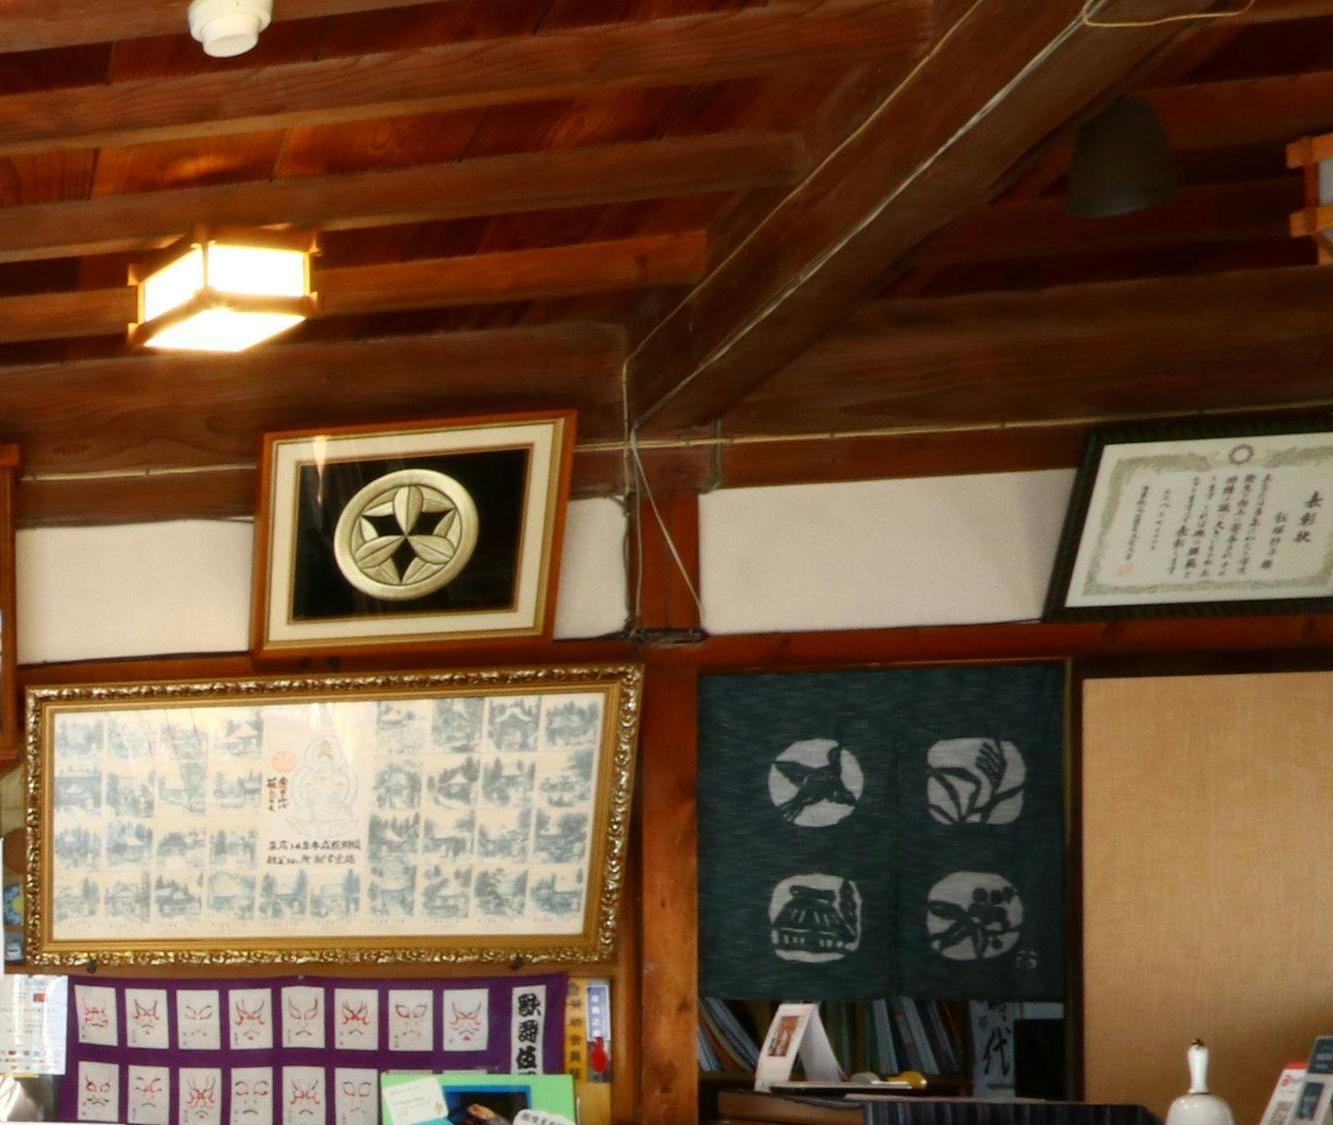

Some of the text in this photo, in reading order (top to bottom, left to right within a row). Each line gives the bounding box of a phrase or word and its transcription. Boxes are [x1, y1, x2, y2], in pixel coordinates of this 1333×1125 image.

[1294, 490, 1324, 544] 表彰状
[516, 992, 541, 1075] 歌舞伎
